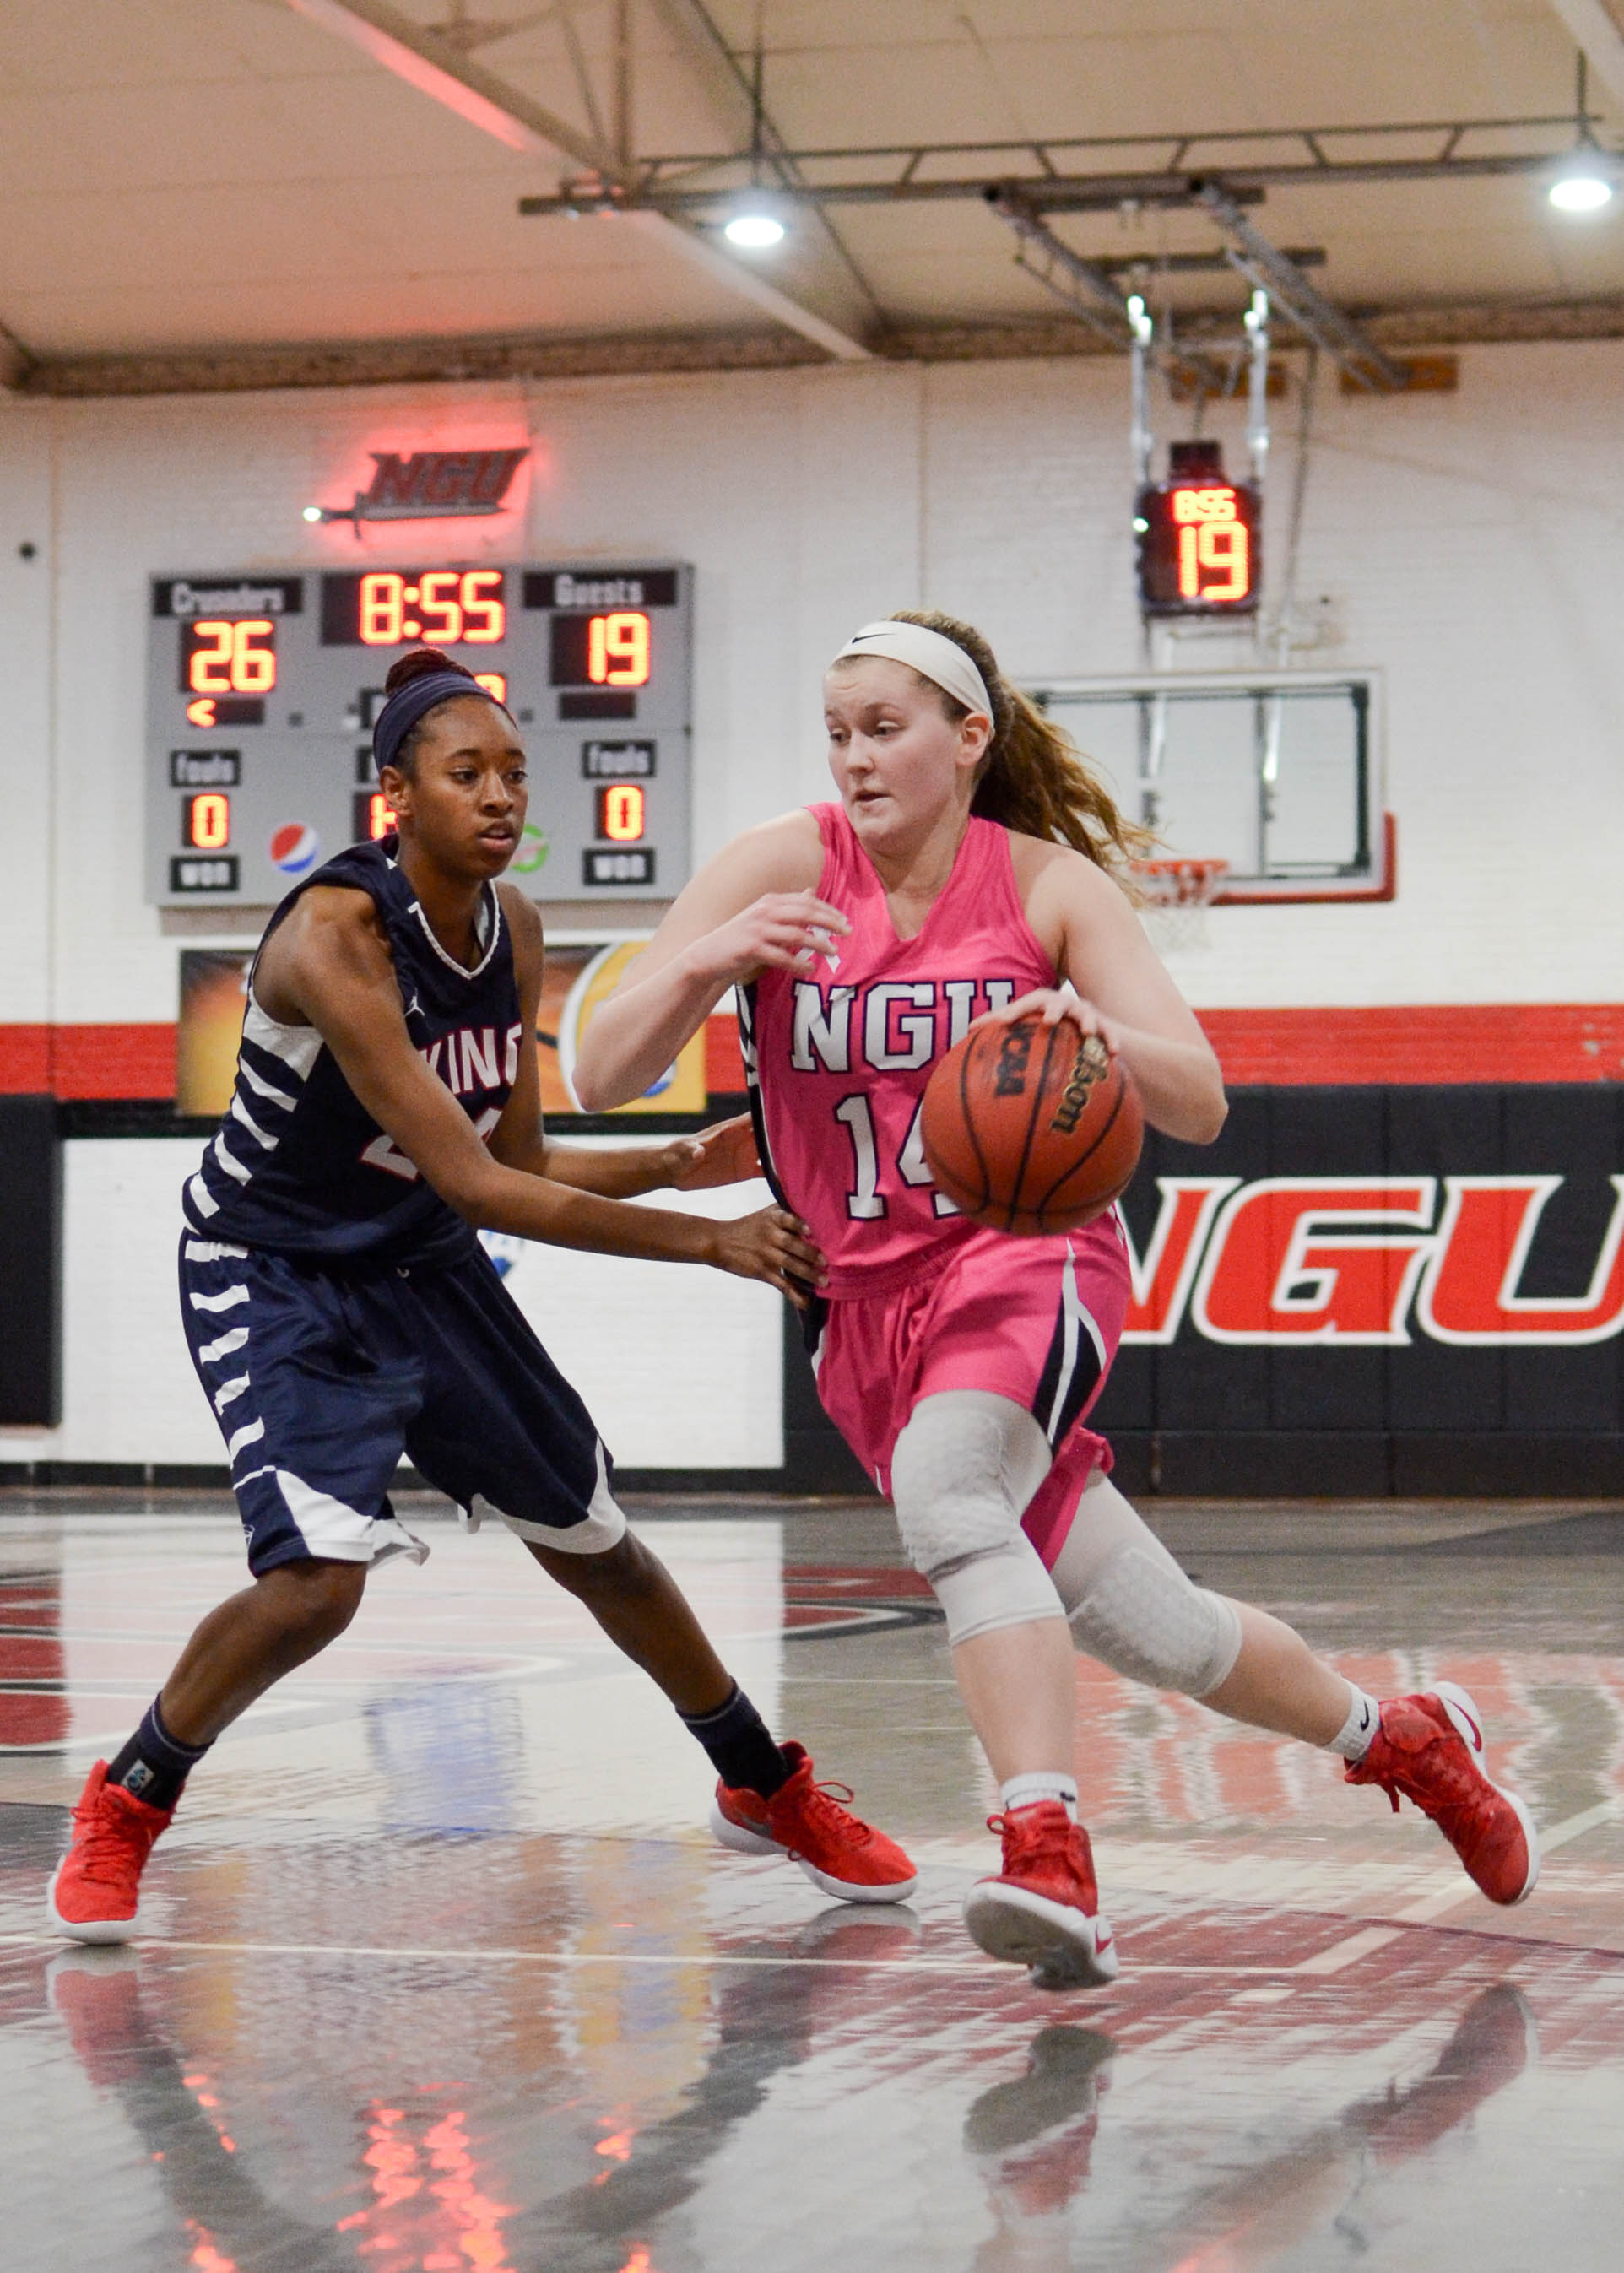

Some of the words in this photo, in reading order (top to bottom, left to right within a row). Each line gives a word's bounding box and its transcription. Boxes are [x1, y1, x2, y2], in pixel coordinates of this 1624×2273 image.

[369, 448, 530, 505] NGU
[555, 574, 645, 606] Guests
[1179, 521, 1249, 602] 19
[360, 572, 506, 646] 8:55
[189, 619, 278, 694] 26
[588, 612, 651, 687] 19
[192, 793, 230, 849] 0
[604, 784, 644, 841] 0
